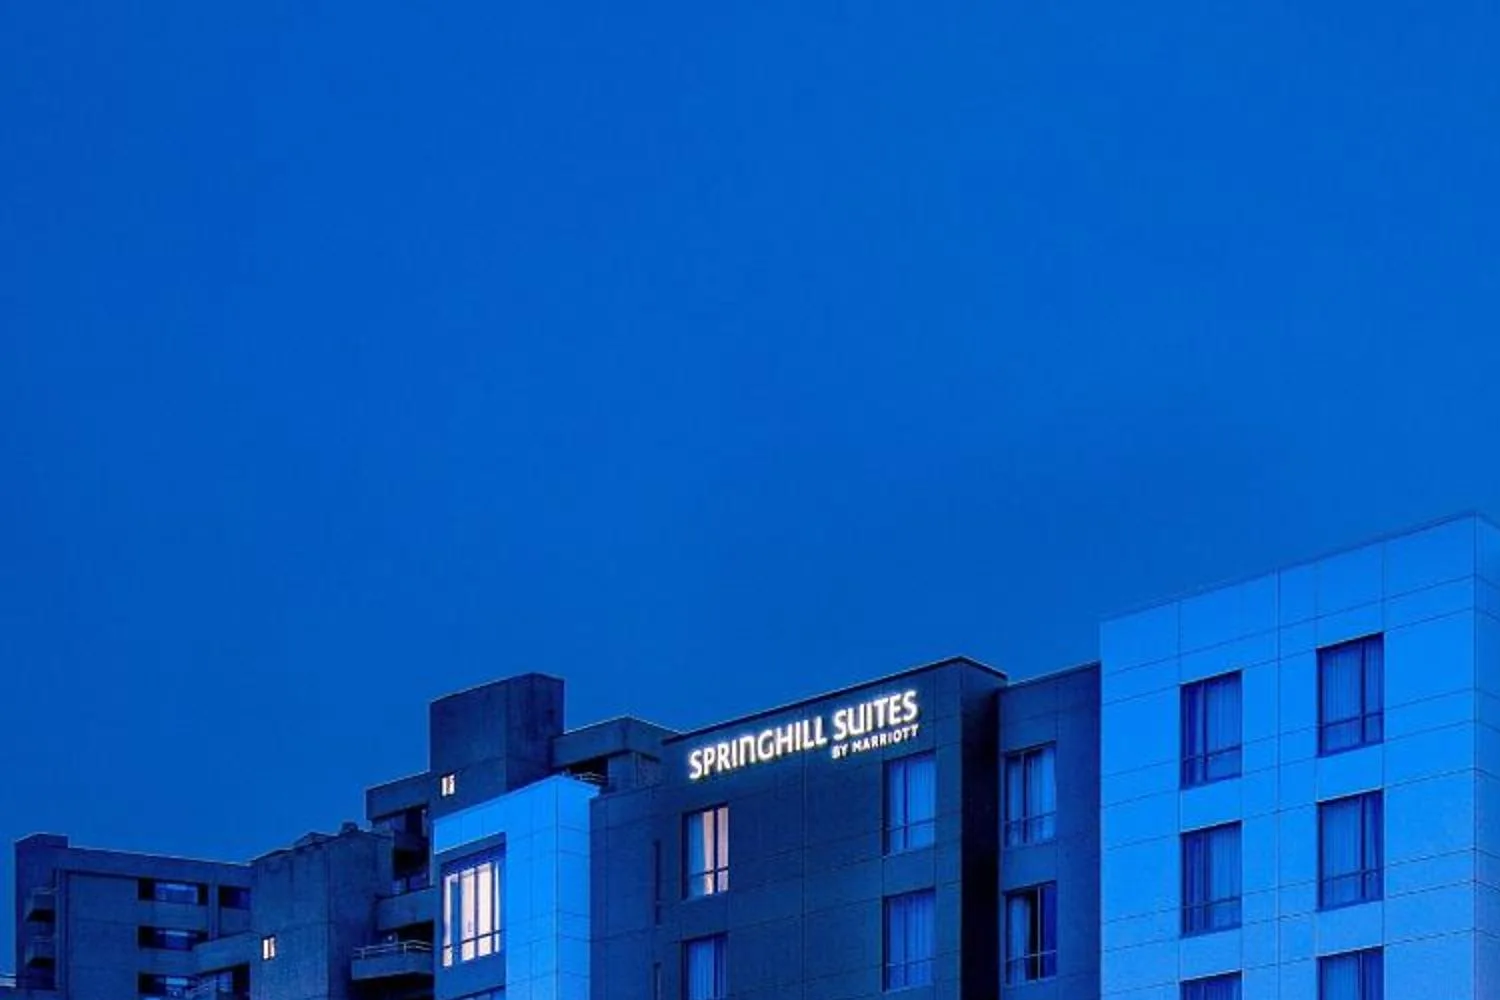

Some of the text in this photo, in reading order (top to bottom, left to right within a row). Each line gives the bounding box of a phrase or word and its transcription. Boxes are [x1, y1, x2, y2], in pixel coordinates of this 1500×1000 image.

[688, 690, 919, 779] SPRINGHILL SUITES
[831, 723, 920, 759] BY MARRIOTT
